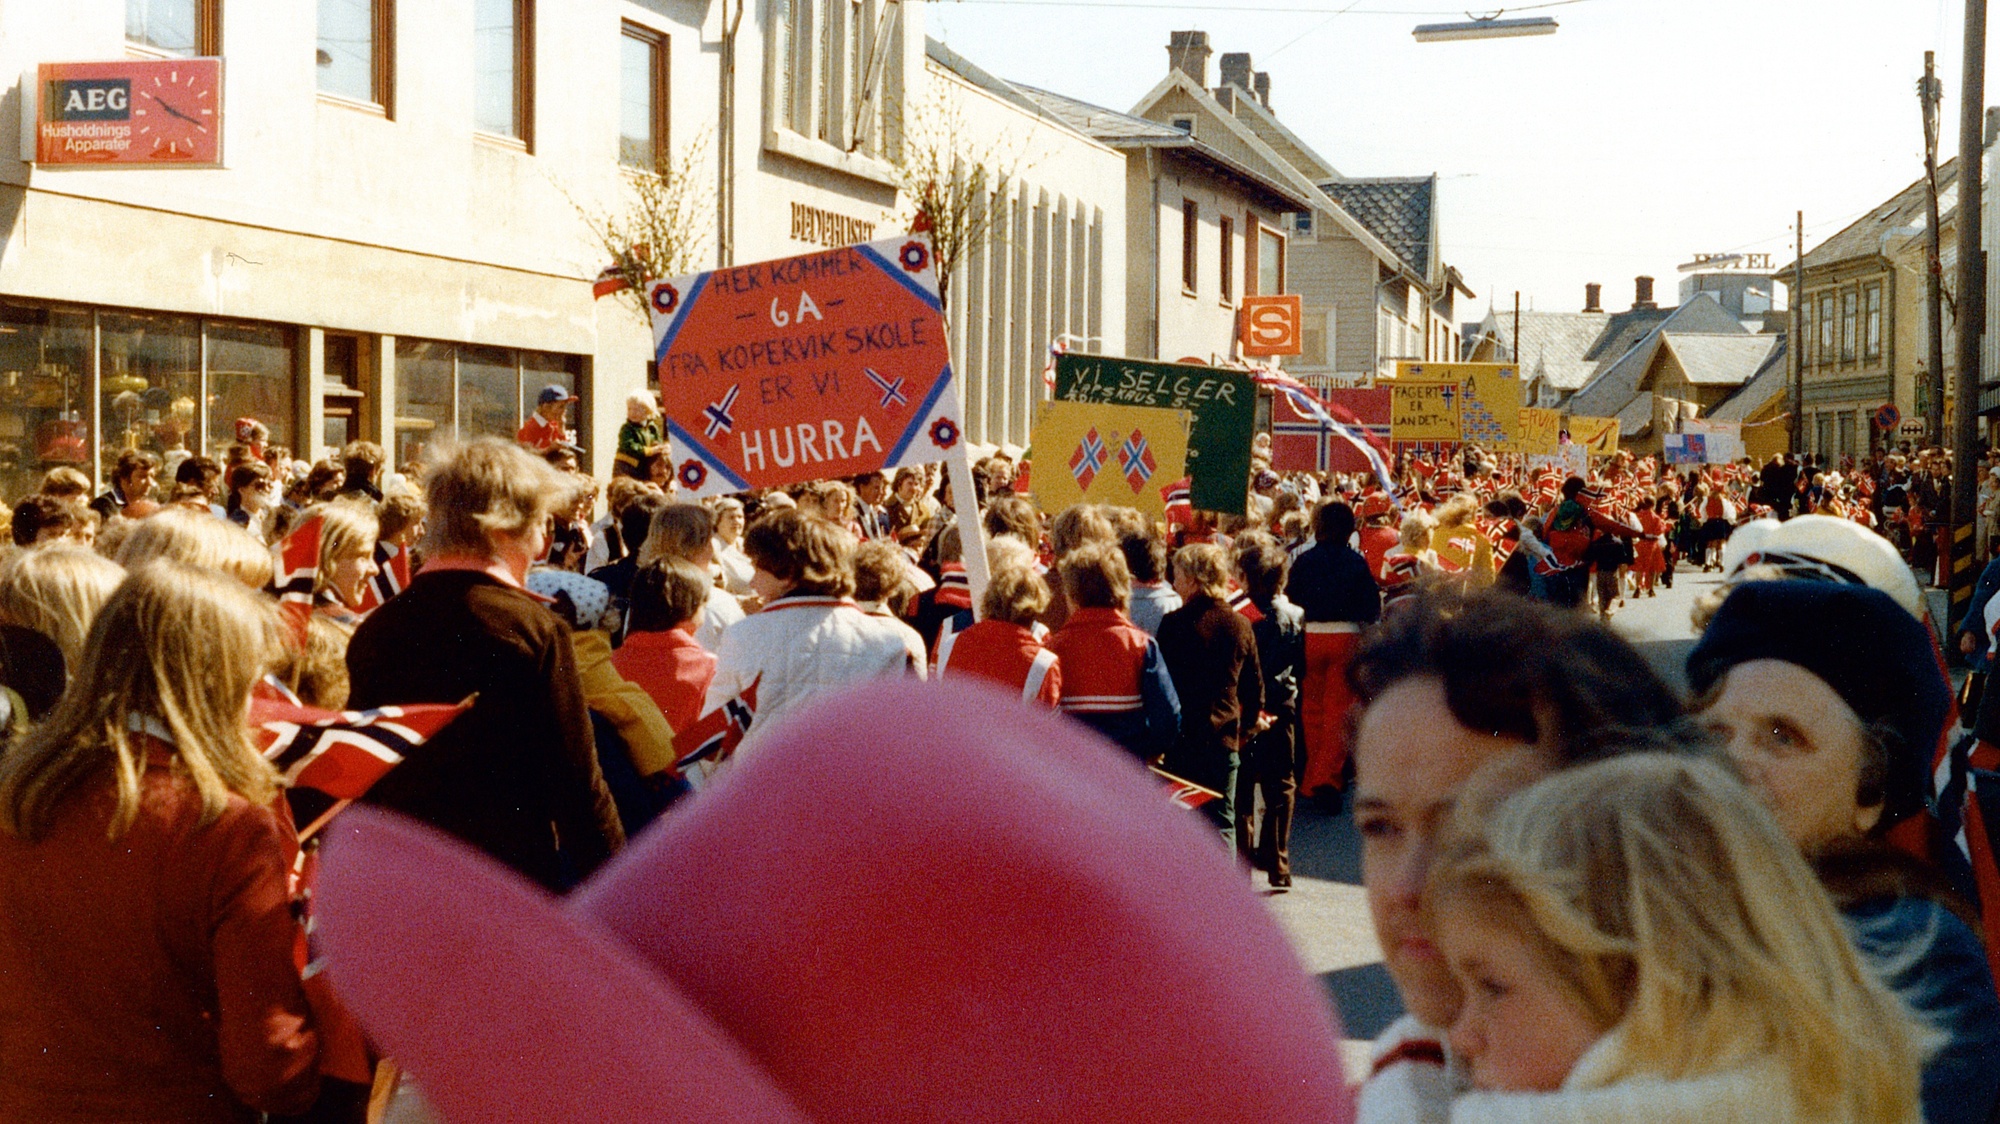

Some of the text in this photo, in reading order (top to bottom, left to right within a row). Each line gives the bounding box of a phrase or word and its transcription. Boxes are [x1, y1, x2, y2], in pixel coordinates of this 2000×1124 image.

[64, 88, 128, 112] AEG
[42, 123, 132, 139] Husholdnings
[65, 138, 132, 153] Apparater
[789, 201, 876, 247] BEDEHUSET
[713, 250, 864, 295] HER KOMMER
[1252, 306, 1291, 346] S
[669, 318, 927, 378] FRA KOPERVIK SKOLE
[760, 370, 840, 405] ER VI
[1069, 383, 1156, 405] LAPSKAUS
[1119, 366, 1237, 406] SELGER
[1395, 386, 1439, 399] FAGERT
[1410, 401, 1423, 411] ER
[740, 415, 883, 472] HURRA
